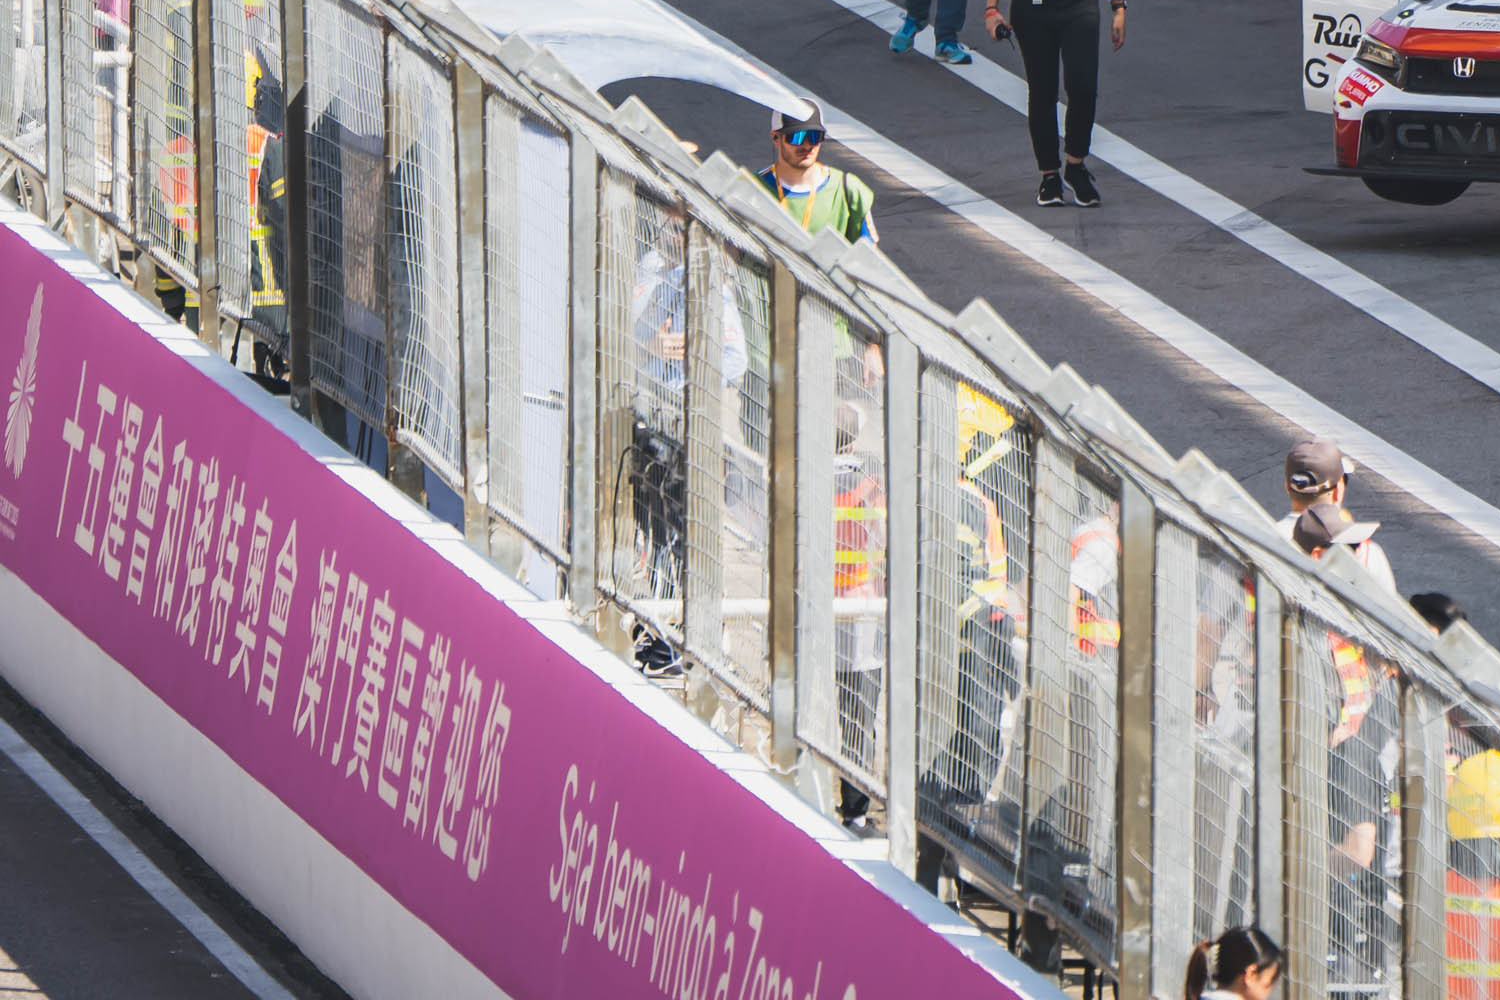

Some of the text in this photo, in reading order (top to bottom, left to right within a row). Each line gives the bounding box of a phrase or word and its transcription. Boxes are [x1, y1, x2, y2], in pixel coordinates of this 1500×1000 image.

[292, 547, 512, 876] 澳門賽區歡迎您
[549, 763, 598, 955] Seja
[592, 801, 716, 1000] bem-vindo
